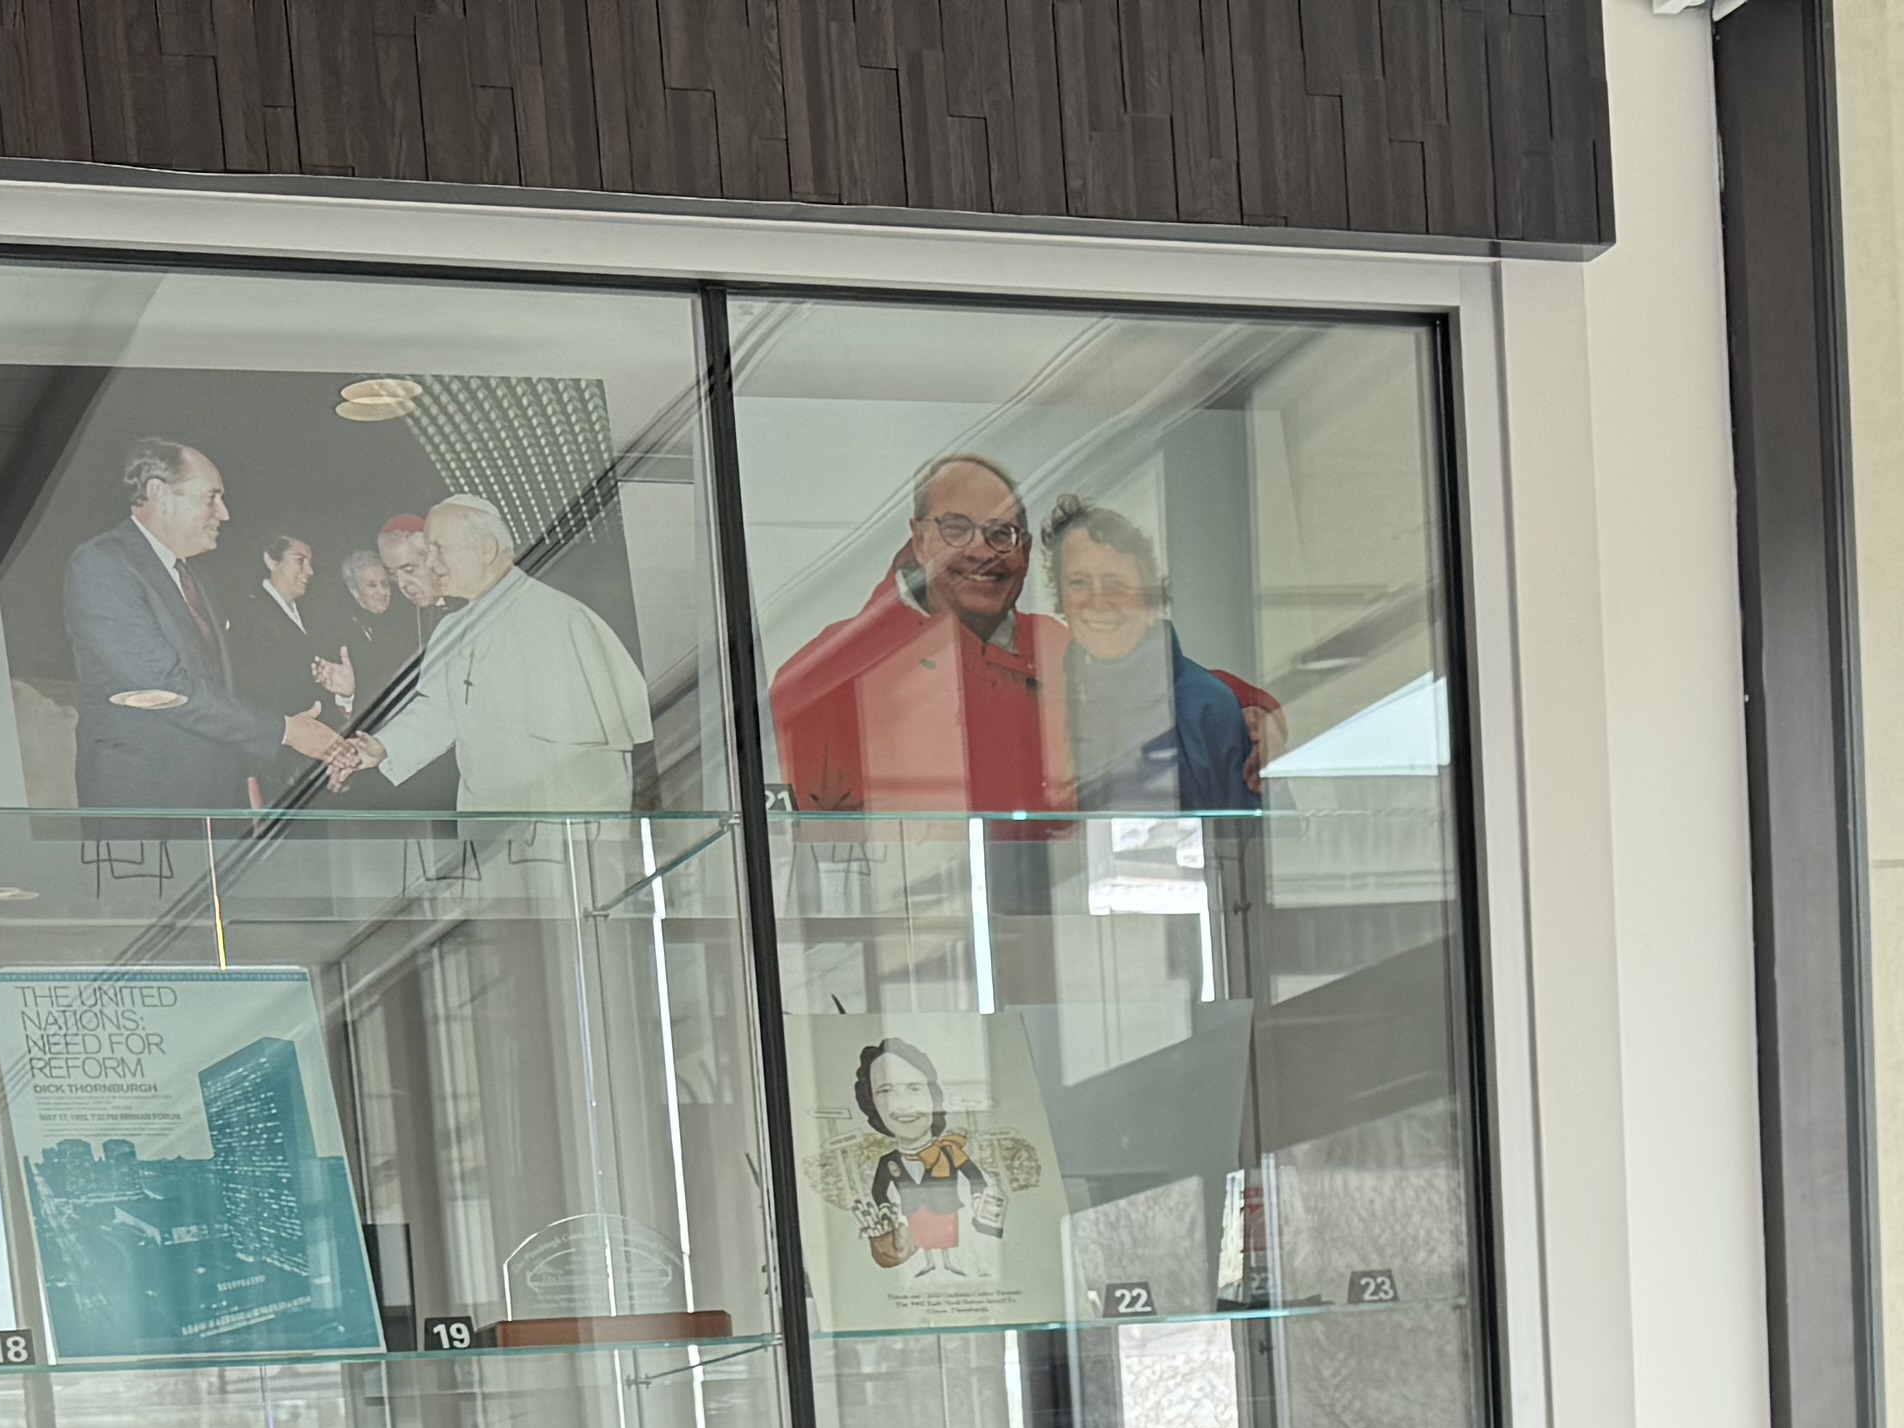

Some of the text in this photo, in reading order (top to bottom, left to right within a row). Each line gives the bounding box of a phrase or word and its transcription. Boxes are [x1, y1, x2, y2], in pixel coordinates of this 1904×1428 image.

[15, 984, 178, 1008] THE UNITED
[21, 1008, 147, 1032] NATIONS:
[26, 1033, 166, 1055] NEED FOR
[29, 1056, 145, 1080] REFORM
[33, 1083, 158, 1094] DICK THORNBURGH
[1360, 1276, 1394, 1300] 23
[1114, 1288, 1152, 1313] 22
[433, 1322, 471, 1349] 19
